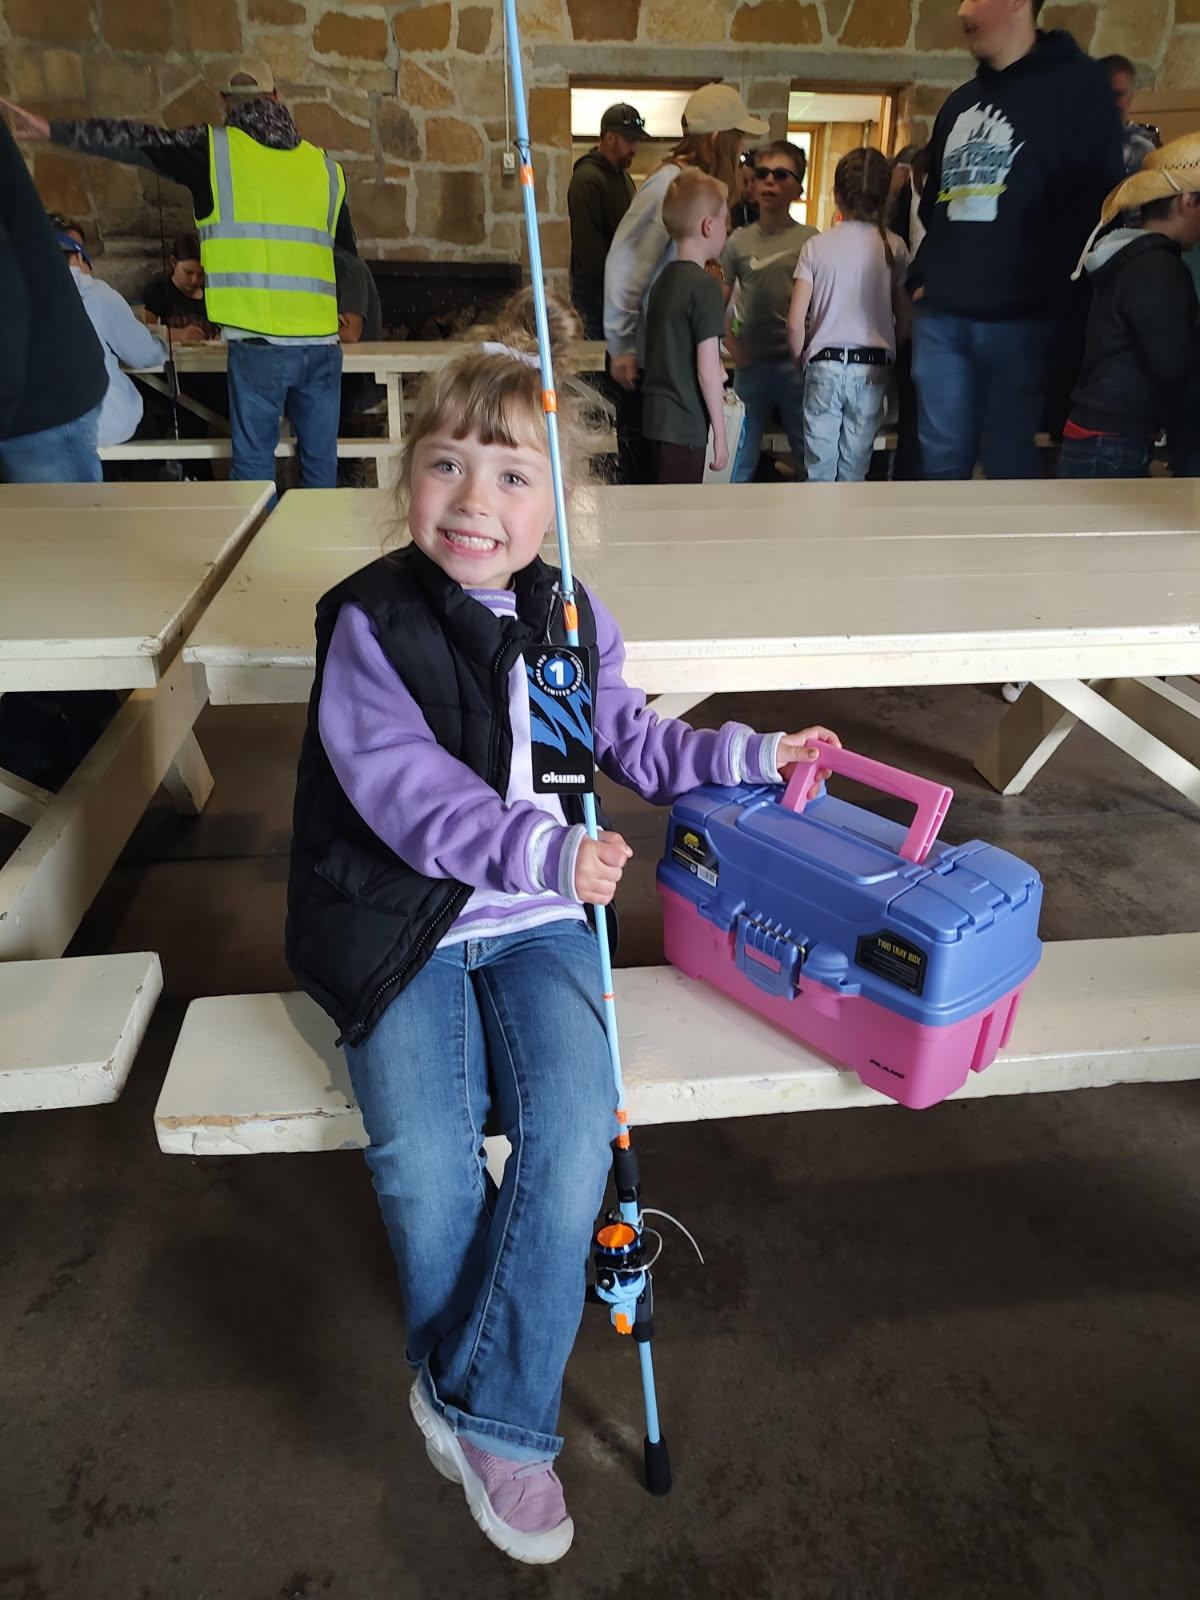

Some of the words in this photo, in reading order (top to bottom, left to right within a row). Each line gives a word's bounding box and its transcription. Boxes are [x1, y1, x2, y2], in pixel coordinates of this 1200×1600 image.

[549, 660, 564, 686] 1
[543, 684, 570, 697] LIMITED
[541, 771, 585, 784] okuma
[878, 938, 892, 952] TWO
[892, 945, 907, 959] TRAY
[908, 952, 921, 966] BOX
